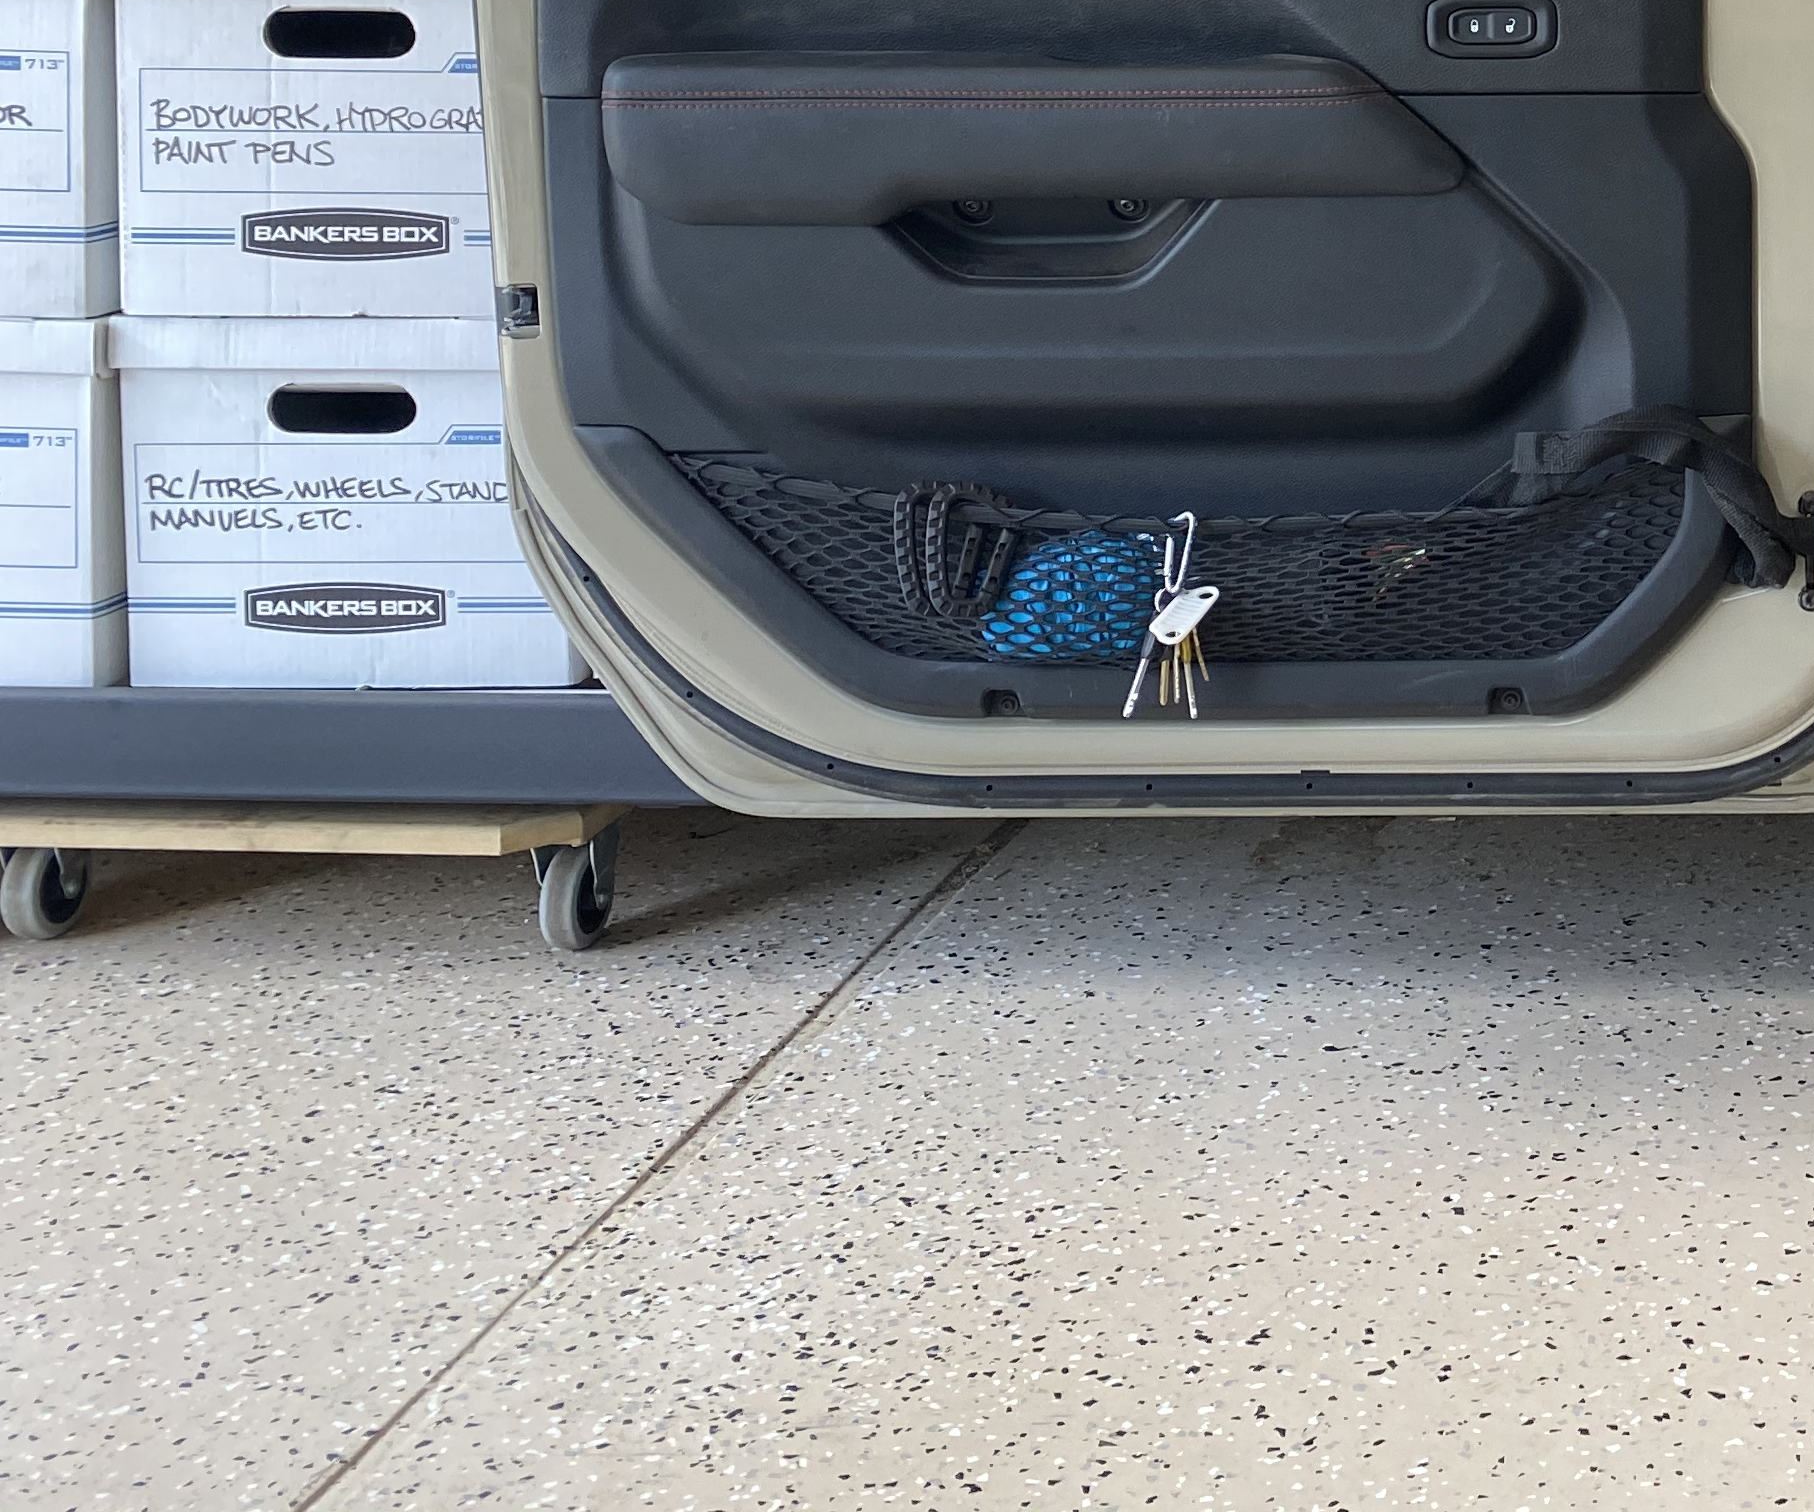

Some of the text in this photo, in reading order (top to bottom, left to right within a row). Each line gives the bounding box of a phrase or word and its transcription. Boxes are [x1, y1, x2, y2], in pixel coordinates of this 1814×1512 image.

[335, 101, 483, 133] HYDROGRA
[152, 136, 335, 166] PAINT PENS
[253, 225, 439, 244] BANKERS BOX
[299, 509, 363, 531] ETC.
[255, 600, 437, 618] BANKERS BOX
